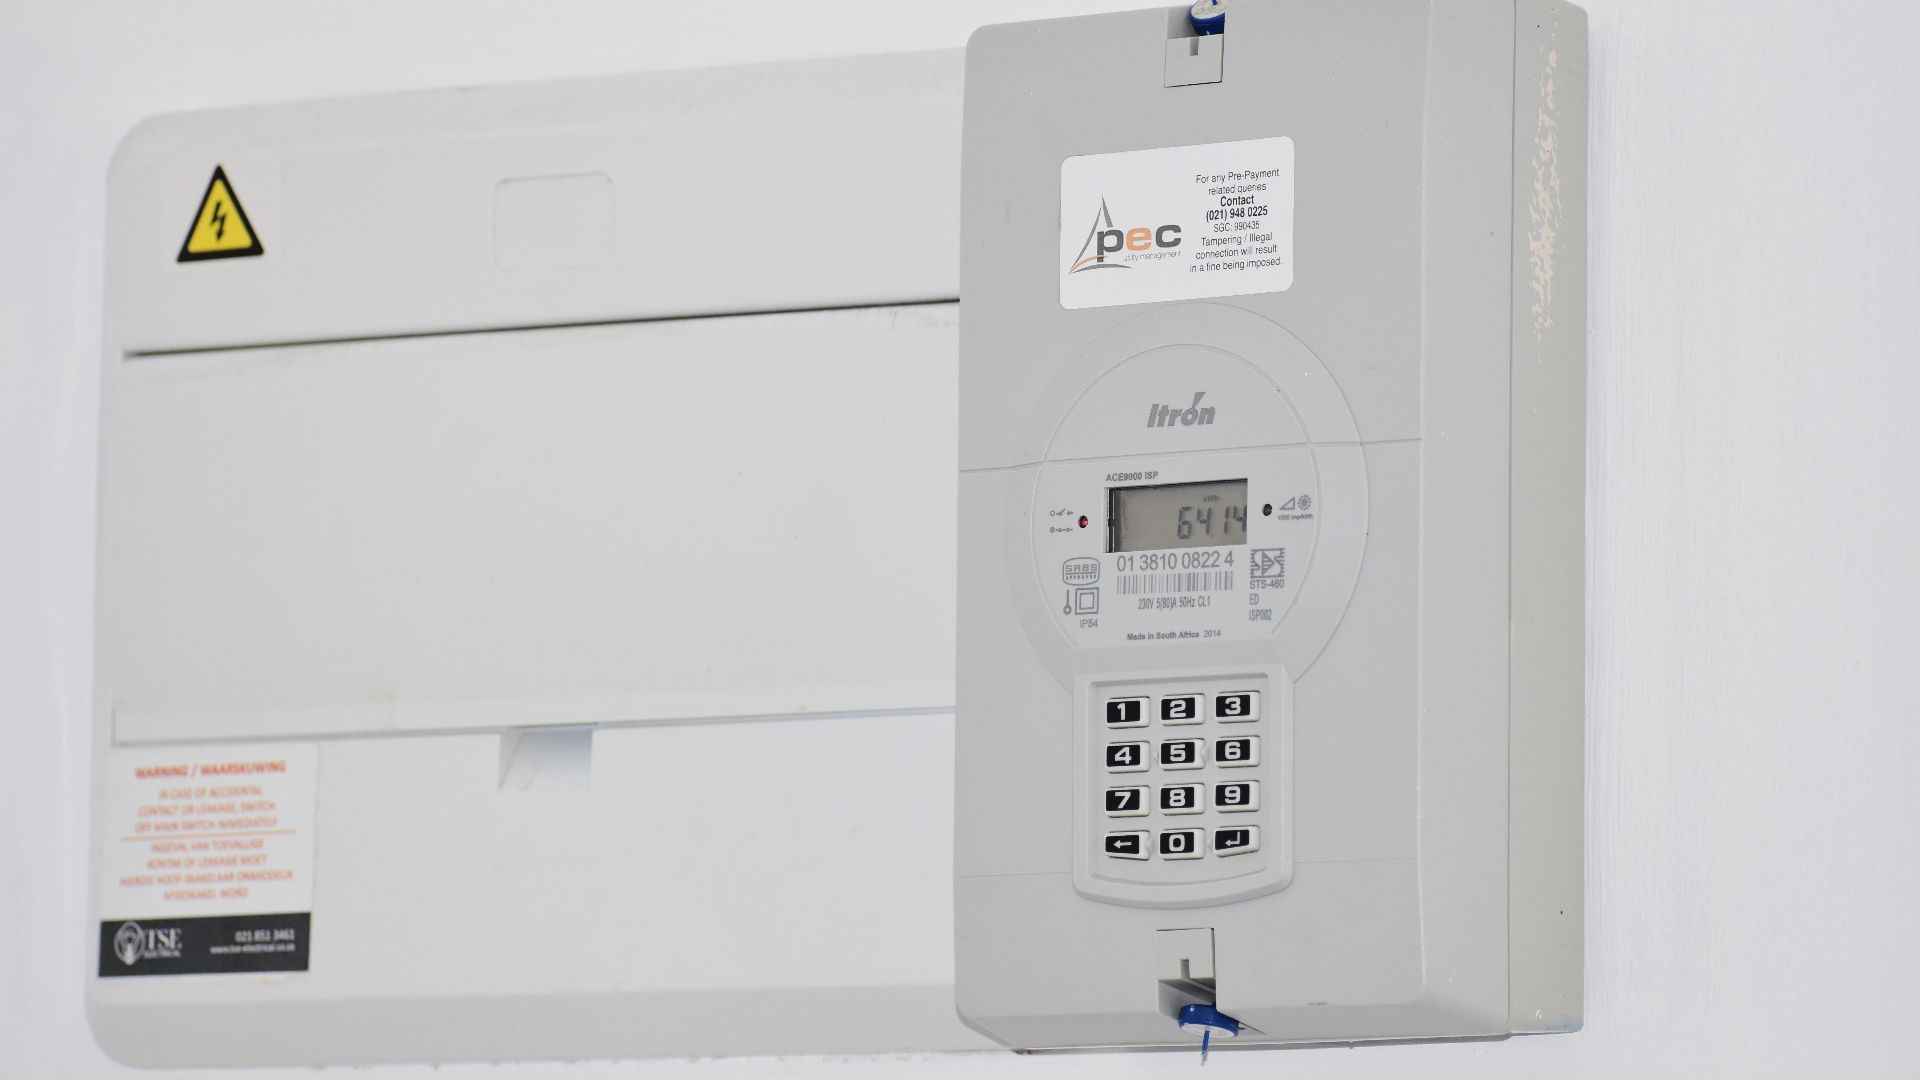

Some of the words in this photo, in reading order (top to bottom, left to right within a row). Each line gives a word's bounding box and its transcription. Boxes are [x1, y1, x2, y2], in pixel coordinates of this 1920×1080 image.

[1196, 174, 1209, 184] For
[1212, 174, 1226, 184] any
[1228, 168, 1280, 181] Pre-Payment
[1208, 185, 1236, 195] related
[1238, 183, 1267, 194] queries
[1220, 194, 1254, 206] Contact
[1206, 208, 1228, 222] (021)
[1230, 207, 1245, 218] 948
[1247, 205, 1268, 217] 0225
[1213, 222, 1232, 232] SGC:
[1234, 220, 1260, 231] 990435
[1096, 224, 1182, 263] pec
[1201, 236, 1242, 247] Tampering
[1249, 232, 1273, 244] Illegal
[1196, 248, 1238, 260] connection
[1256, 244, 1278, 254] result
[1190, 264, 1197, 272] in
[1206, 262, 1221, 271] fine
[1222, 260, 1245, 270] being
[1246, 256, 1283, 269] imposed.
[1106, 472, 1144, 482] ACE9000
[1144, 471, 1158, 480] ISP
[1203, 494, 1220, 503] kWh
[1117, 555, 1134, 572] 01
[1140, 552, 1178, 571] 3810
[1182, 550, 1220, 570] 0822
[1224, 550, 1235, 566] 4
[1138, 598, 1154, 610] 230V
[1156, 598, 1177, 612] 5(80)A
[1179, 596, 1196, 608] 50Hz
[1250, 593, 1260, 605] ED
[1080, 618, 1098, 629] IP54
[1126, 632, 1146, 641] Made
[1156, 632, 1177, 640] South
[1178, 630, 1200, 639] Africa
[1203, 630, 1222, 638] 2014
[1116, 702, 1126, 721] 1
[1169, 700, 1186, 718] 2
[1224, 697, 1241, 715] 3
[1114, 747, 1132, 765] 4
[1170, 744, 1186, 762] 5
[1224, 742, 1241, 760] 6
[135, 765, 188, 779] WARNING
[171, 788, 192, 799] CASE
[194, 787, 206, 798] OF
[209, 784, 262, 798] ACCIDENTAL
[1114, 791, 1132, 809] 7
[1169, 788, 1186, 807] 8
[1224, 786, 1241, 804] 9
[138, 804, 179, 817] CONTACT
[241, 801, 276, 812] SWITCH
[154, 820, 178, 831] MAIN
[182, 819, 214, 830] SWITCH
[1168, 834, 1186, 852] 0
